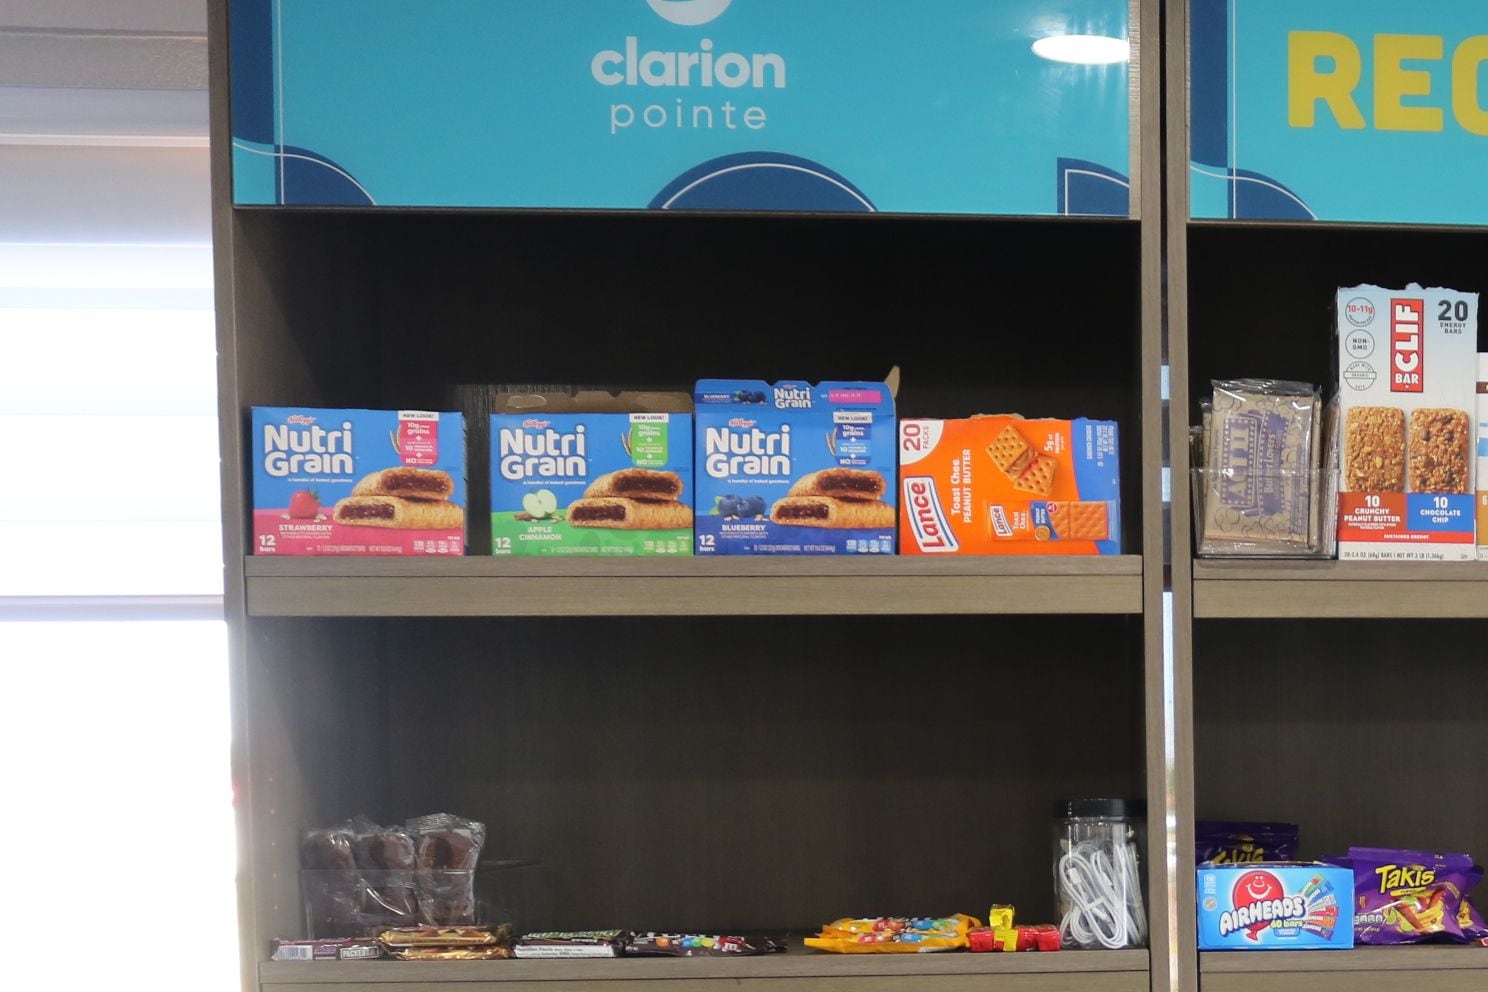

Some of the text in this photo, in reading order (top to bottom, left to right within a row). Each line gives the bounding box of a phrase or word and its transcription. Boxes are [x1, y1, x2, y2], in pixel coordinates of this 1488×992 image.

[591, 36, 786, 88] clarion
[611, 100, 766, 134] pointe
[1348, 305, 1373, 314] 10-11g
[1438, 300, 1468, 321] 20
[1395, 305, 1418, 371] CLIF
[1396, 374, 1418, 384] BAR
[774, 388, 810, 400] Nutri
[775, 399, 811, 408] Grain
[264, 422, 352, 453] Nutri
[500, 425, 585, 457] Nutri
[706, 424, 790, 455] Nutri
[903, 423, 921, 451] 20
[264, 452, 353, 476] Grain
[501, 456, 586, 480] Grain
[706, 453, 790, 478] Grain
[951, 459, 960, 515] Toast Chee
[1365, 496, 1379, 507] 10
[1434, 497, 1448, 508] 10
[911, 483, 944, 548] Lance
[994, 507, 1007, 535] Lance
[259, 535, 276, 546] 12
[496, 537, 511, 548] 12
[699, 535, 715, 545] 12
[1376, 864, 1435, 893] Takis
[1220, 897, 1305, 935] AIRHEADS
[1283, 919, 1303, 928] bars
